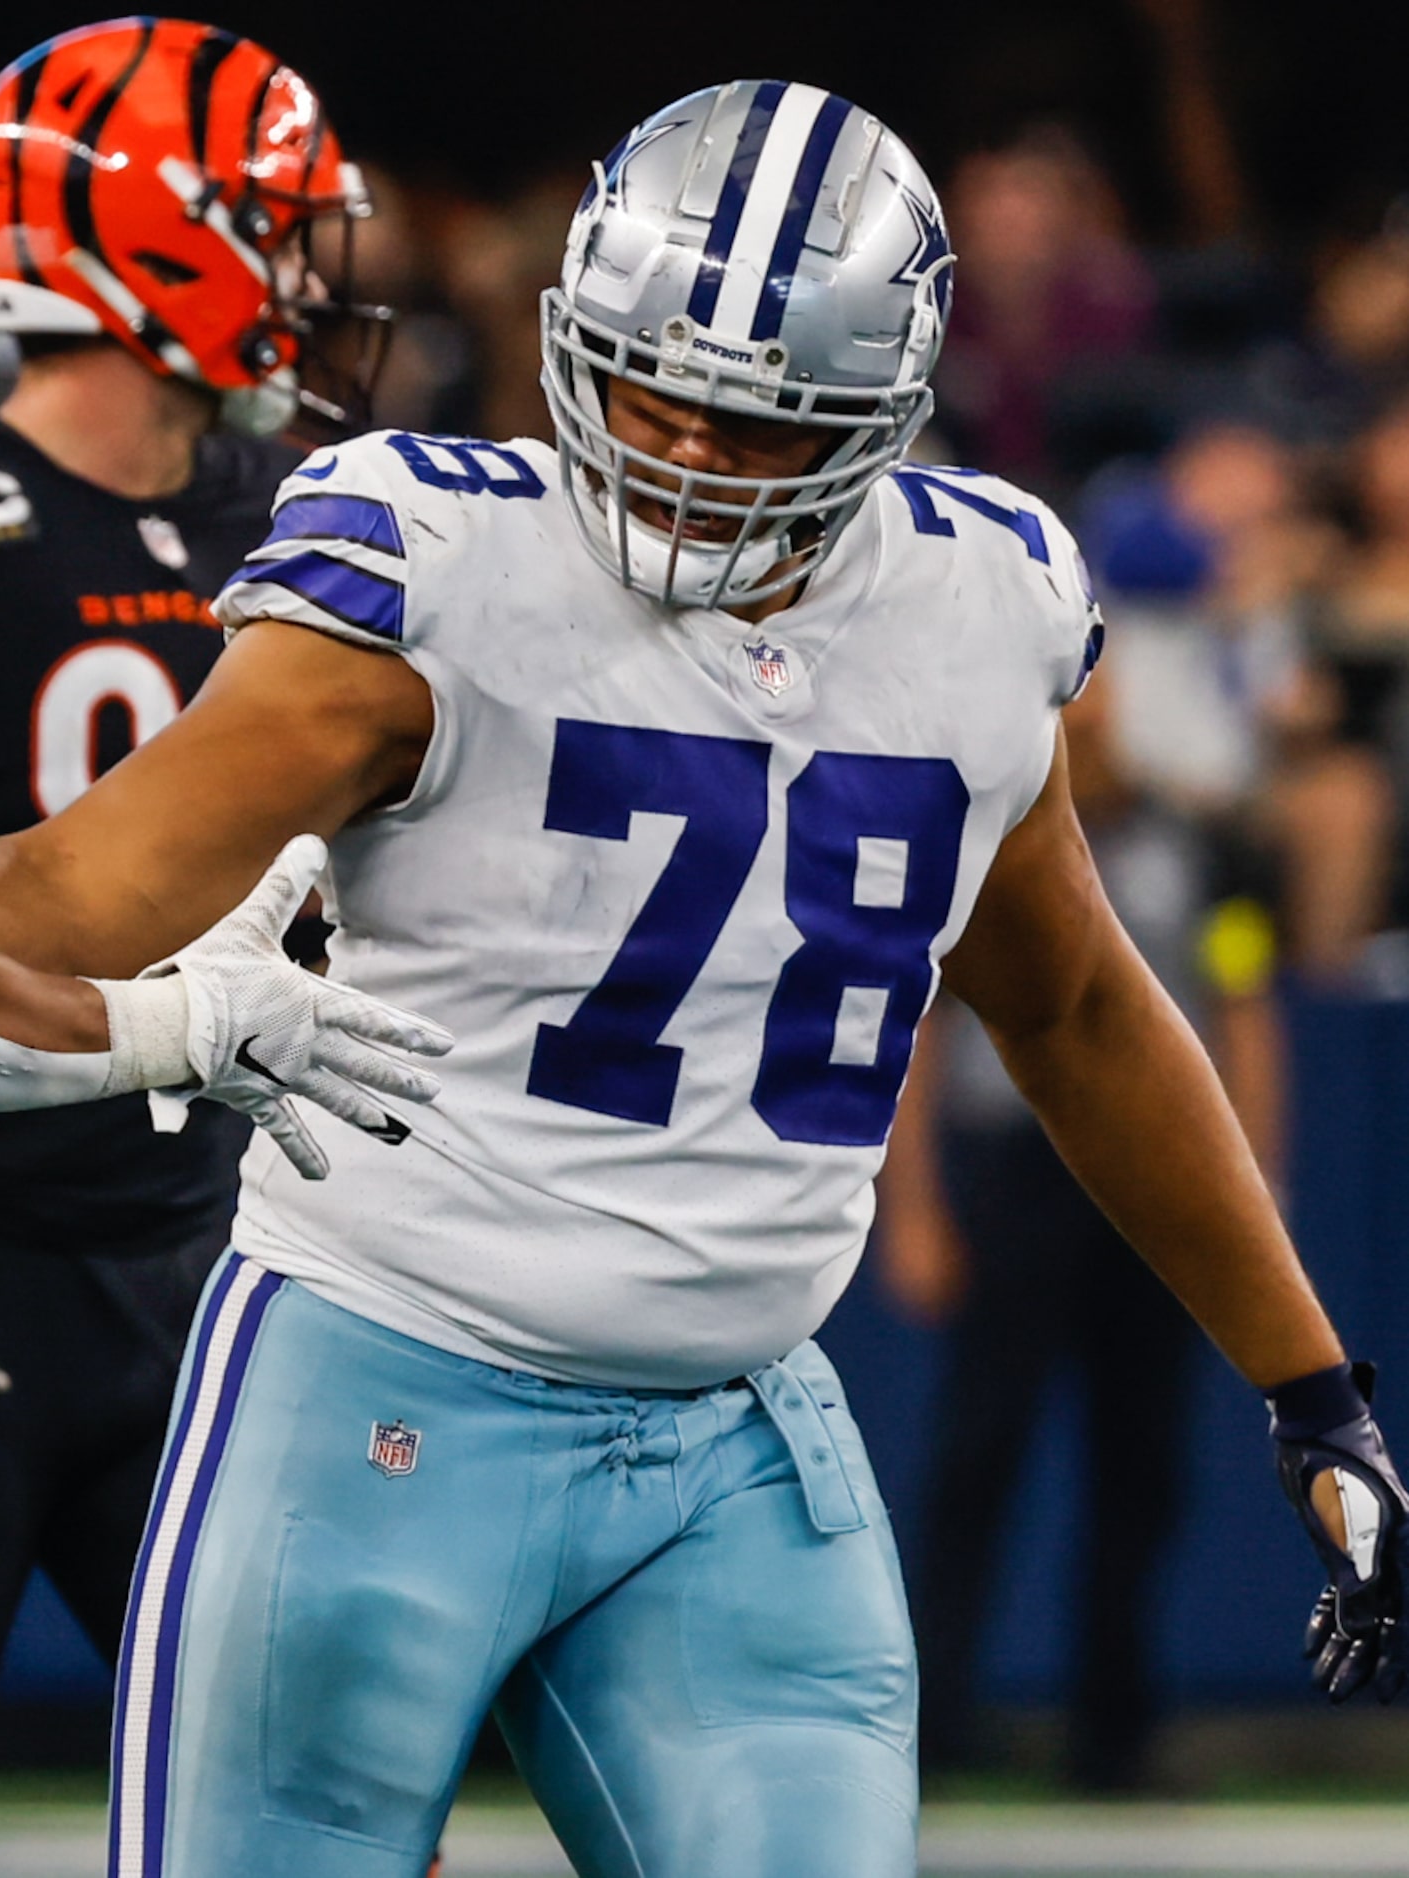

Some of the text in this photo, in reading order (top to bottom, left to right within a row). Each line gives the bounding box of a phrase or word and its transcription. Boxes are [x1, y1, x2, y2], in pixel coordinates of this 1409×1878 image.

[692, 338, 753, 363] COWBOYS
[526, 717, 971, 1147] 78
[377, 1442, 409, 1467] NFL
